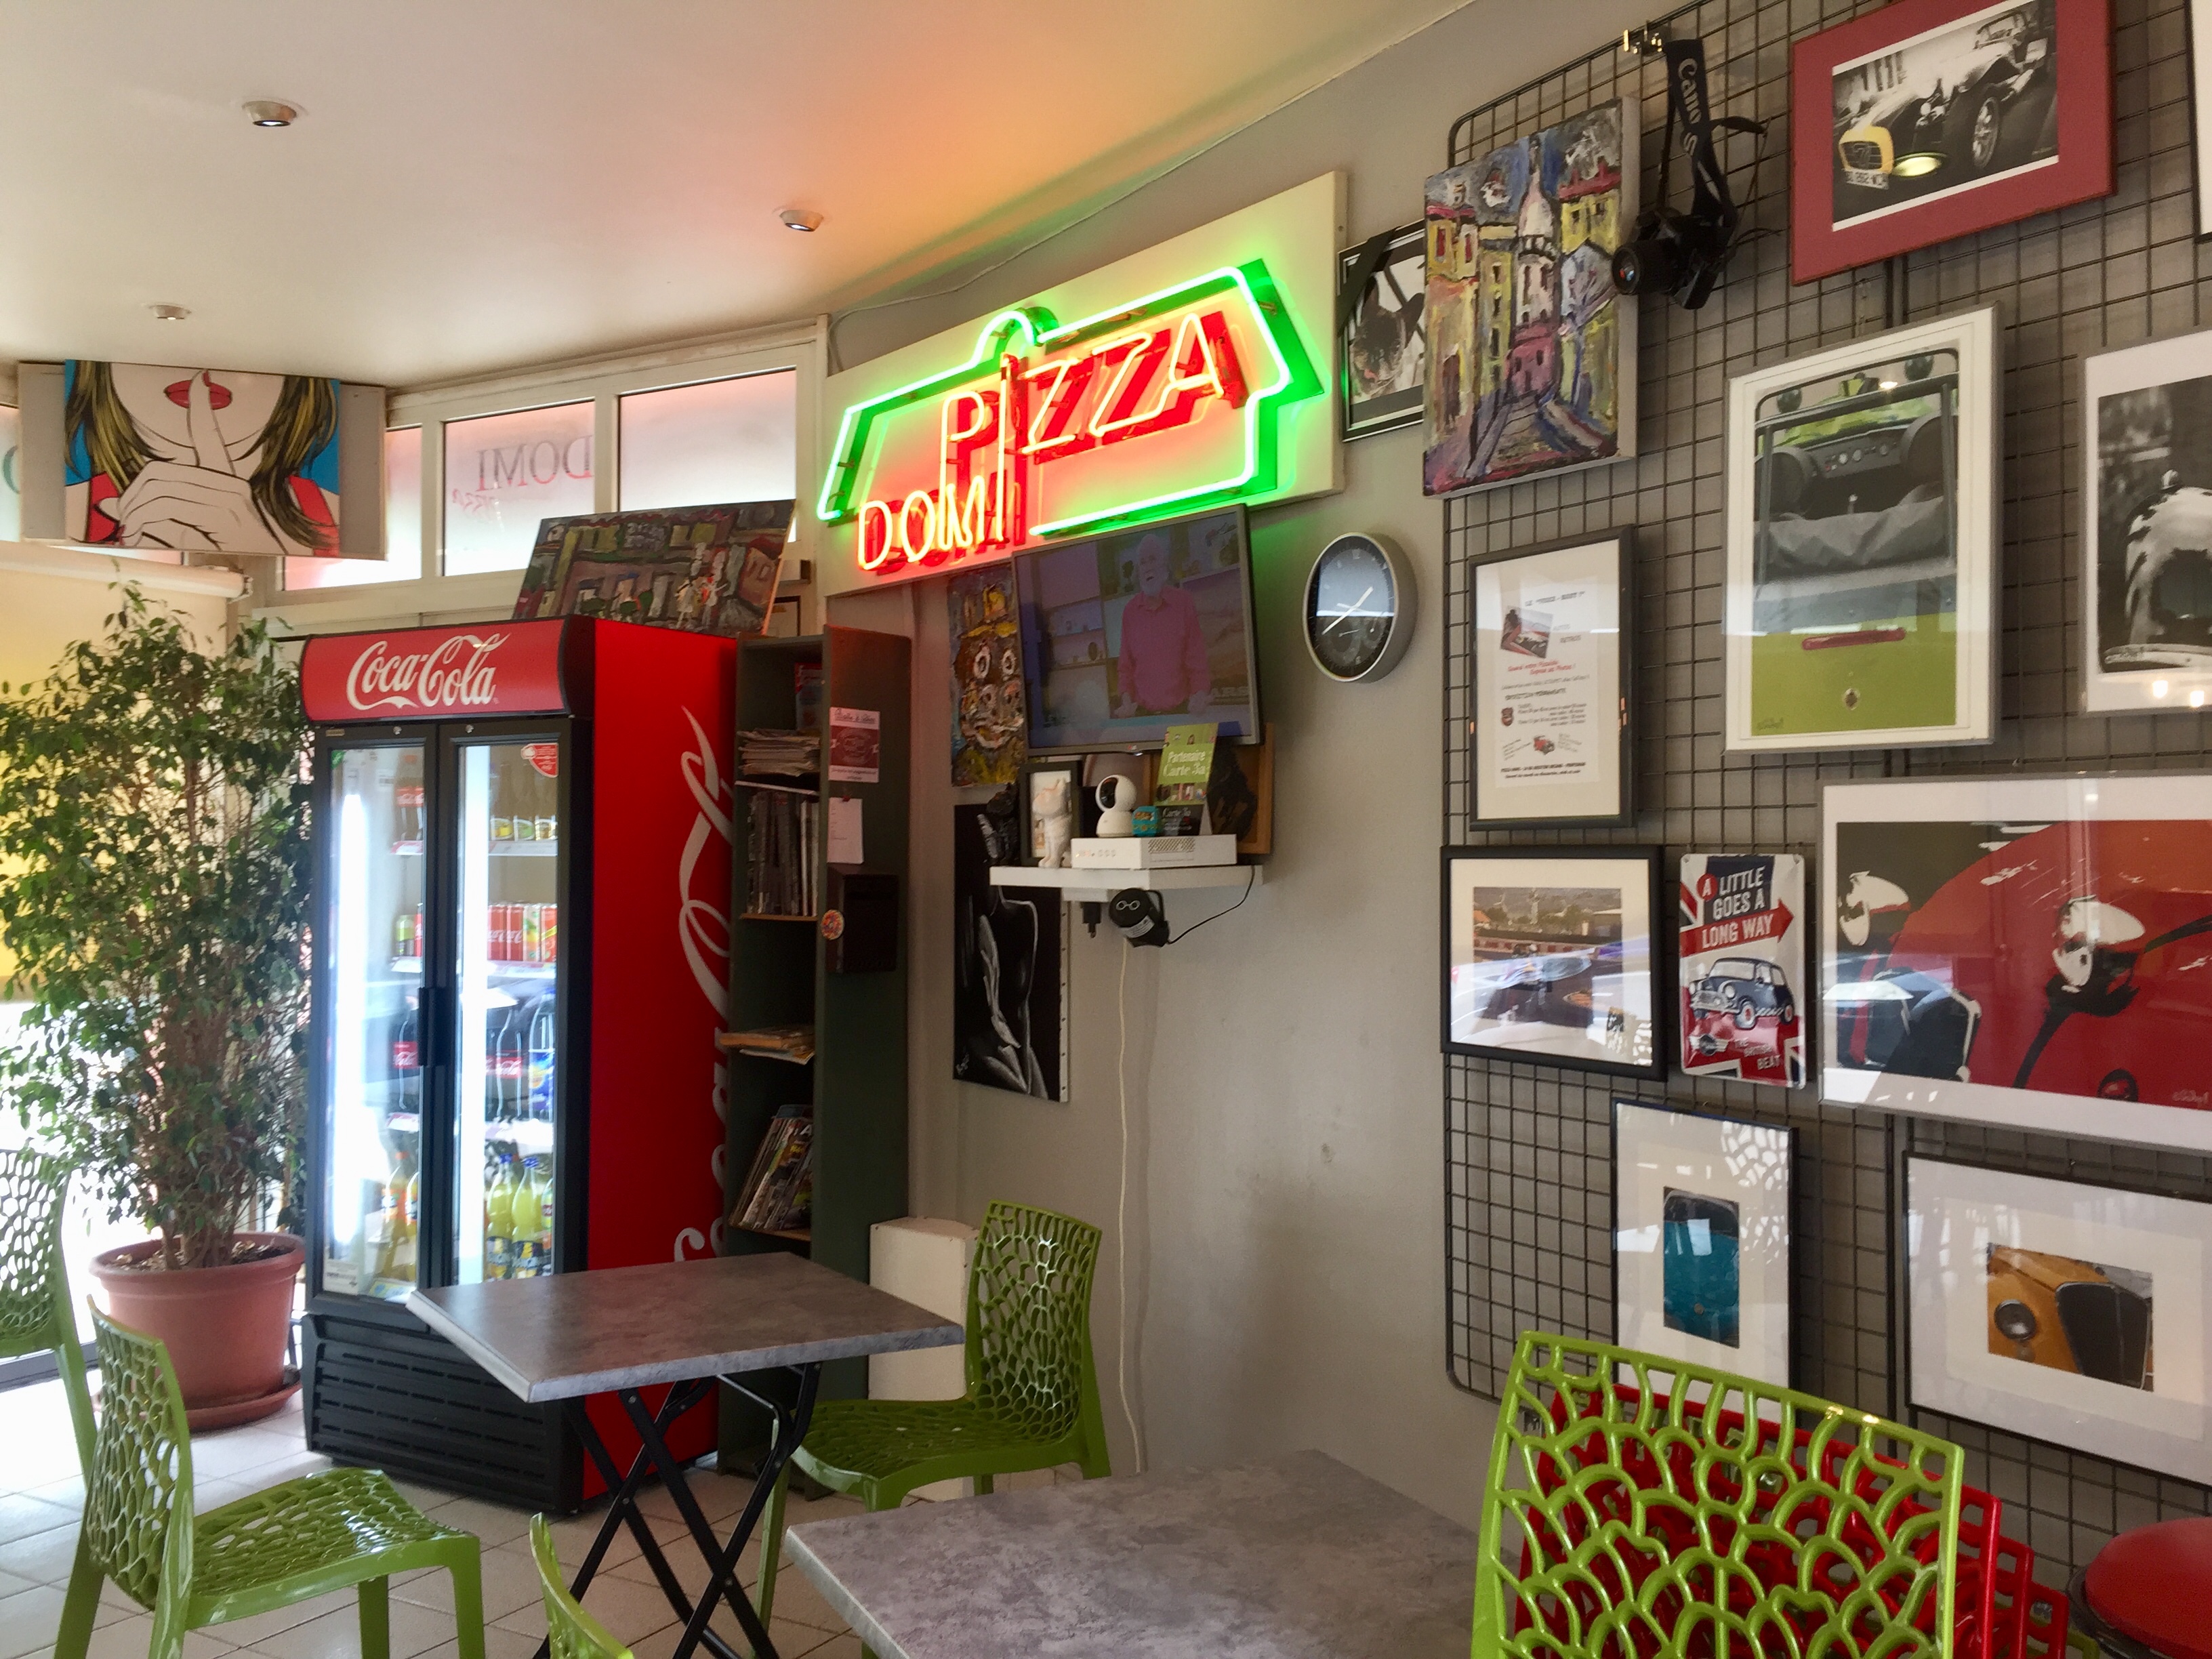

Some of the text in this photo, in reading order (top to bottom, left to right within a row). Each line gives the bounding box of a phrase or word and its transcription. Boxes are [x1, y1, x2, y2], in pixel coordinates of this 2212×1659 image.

[1678, 58, 1702, 125] Cano
[939, 312, 1244, 515] PIZZA
[857, 457, 1010, 571] DOMI
[346, 633, 511, 710] Coca-Cola
[1163, 764, 1191, 777] Carte
[1167, 750, 1206, 764] Partenaire
[1702, 865, 1765, 897] A LITTLE
[1713, 888, 1765, 920] GOES A
[1702, 914, 1774, 949] LONG WAY
[1757, 1054, 1782, 1071] BEAT
